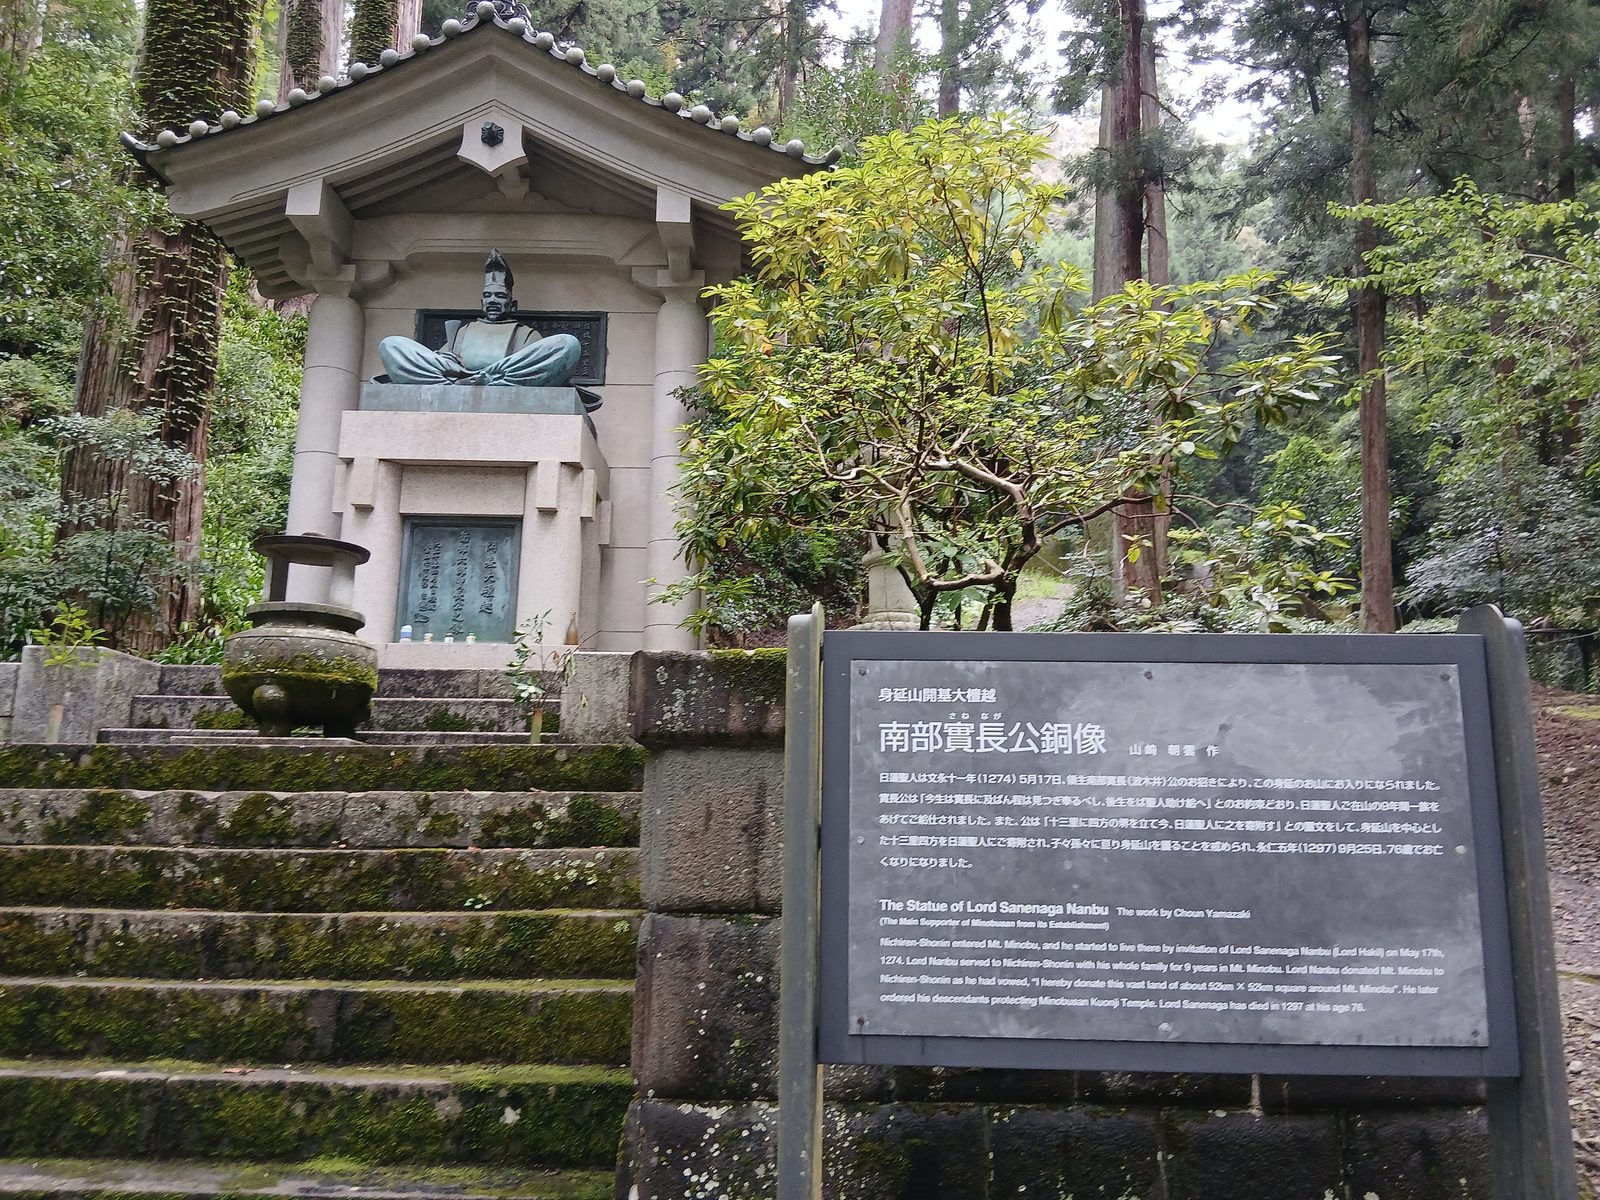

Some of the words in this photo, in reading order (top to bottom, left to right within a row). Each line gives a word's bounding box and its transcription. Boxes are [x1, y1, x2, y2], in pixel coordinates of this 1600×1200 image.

[878, 687, 997, 703] 身延山開基大檀越
[878, 720, 1107, 755] 南部實長公銅像
[1205, 744, 1219, 758] 作
[879, 857, 973, 868] くなりになりました。
[879, 898, 904, 912] The
[906, 899, 948, 912] Statue
[950, 900, 965, 913] of
[967, 900, 997, 913] Lord
[999, 900, 1064, 917] Sanenaga
[1066, 902, 1109, 916] Nanbu
[1116, 906, 1135, 917] The
[1136, 907, 1159, 917] work
[1160, 907, 1173, 920] by
[1174, 908, 1205, 918] Choun
[1206, 908, 1251, 919] Yamazaki
[879, 917, 899, 927] (The
[899, 917, 919, 926] Main
[920, 917, 961, 928] Supporter
[961, 918, 971, 927] of
[971, 918, 1016, 928] Minobusan
[1016, 919, 1036, 928] from
[1037, 920, 1048, 929] its
[880, 937, 951, 948] Nichiren-Shonin
[952, 938, 987, 949] entered
[987, 939, 1003, 949] Mt.
[1004, 939, 1041, 951] Minobu,
[1042, 940, 1061, 951] and
[1061, 940, 1074, 951] he
[1074, 942, 1107, 952] started
[1108, 942, 1119, 952] to
[1119, 942, 1136, 952] live
[1137, 943, 1162, 953] there
[1162, 943, 1175, 955] by
[1176, 943, 1218, 954] invitation
[1218, 944, 1230, 955] of
[1230, 944, 1253, 955] Lord
[1253, 945, 1300, 958] Sanenaga
[1300, 946, 1332, 956] Nanbu
[1386, 949, 1399, 957] on
[1400, 947, 1420, 959] May
[880, 955, 905, 965] 1274.
[906, 955, 928, 966] Lord
[928, 956, 959, 967] Nanbu
[960, 957, 991, 967] served
[991, 958, 1002, 968] to
[1003, 957, 1075, 969] Nichiren-Shonin
[1075, 959, 1096, 970] with
[1112, 960, 1140, 971] whole
[1140, 961, 1169, 974] family
[1170, 961, 1184, 972] for
[1184, 962, 1192, 972] 9
[1192, 964, 1218, 974] years
[1219, 963, 1229, 973] in
[1229, 963, 1246, 973] Mt.
[1246, 963, 1285, 974] Minobu.
[1286, 964, 1308, 975] Lord
[1309, 965, 1340, 975] Nanbu
[1341, 965, 1380, 975] donated
[1381, 966, 1396, 975] Mt.
[1398, 966, 1433, 976] Minobu
[1434, 967, 1445, 976] to
[880, 973, 951, 985] Nichiren-Shonin
[952, 977, 964, 985] as
[964, 975, 977, 986] he
[978, 975, 997, 986] had
[997, 976, 1031, 988] vowed,
[1041, 977, 1073, 990] hereby
[1074, 978, 1106, 989] donate
[1107, 979, 1125, 989] this
[1126, 980, 1146, 990] vast
[1146, 980, 1168, 990] land
[1168, 980, 1179, 990] of
[1180, 980, 1208, 991] about
[1208, 981, 1235, 992] 52km
[1247, 982, 1274, 992] 52km
[1274, 984, 1307, 995] square
[1308, 984, 1341, 993] around
[1342, 983, 1358, 994] Mt.
[1403, 984, 1417, 994] He
[1418, 985, 1439, 995] later
[880, 992, 916, 1005] ordered
[932, 993, 990, 1005] descendants
[991, 995, 1038, 1008] protecting
[1038, 995, 1089, 1007] Minobusan
[1120, 997, 1158, 1009] Temple.
[1159, 998, 1181, 1009] Lord
[1182, 999, 1229, 1012] Sanenaga
[1229, 1000, 1247, 1011] has
[1248, 1000, 1269, 1011] died
[1270, 1001, 1280, 1011] in
[1281, 1001, 1304, 1011] 1297
[1305, 1002, 1315, 1012] at
[1332, 1004, 1350, 1014] age
